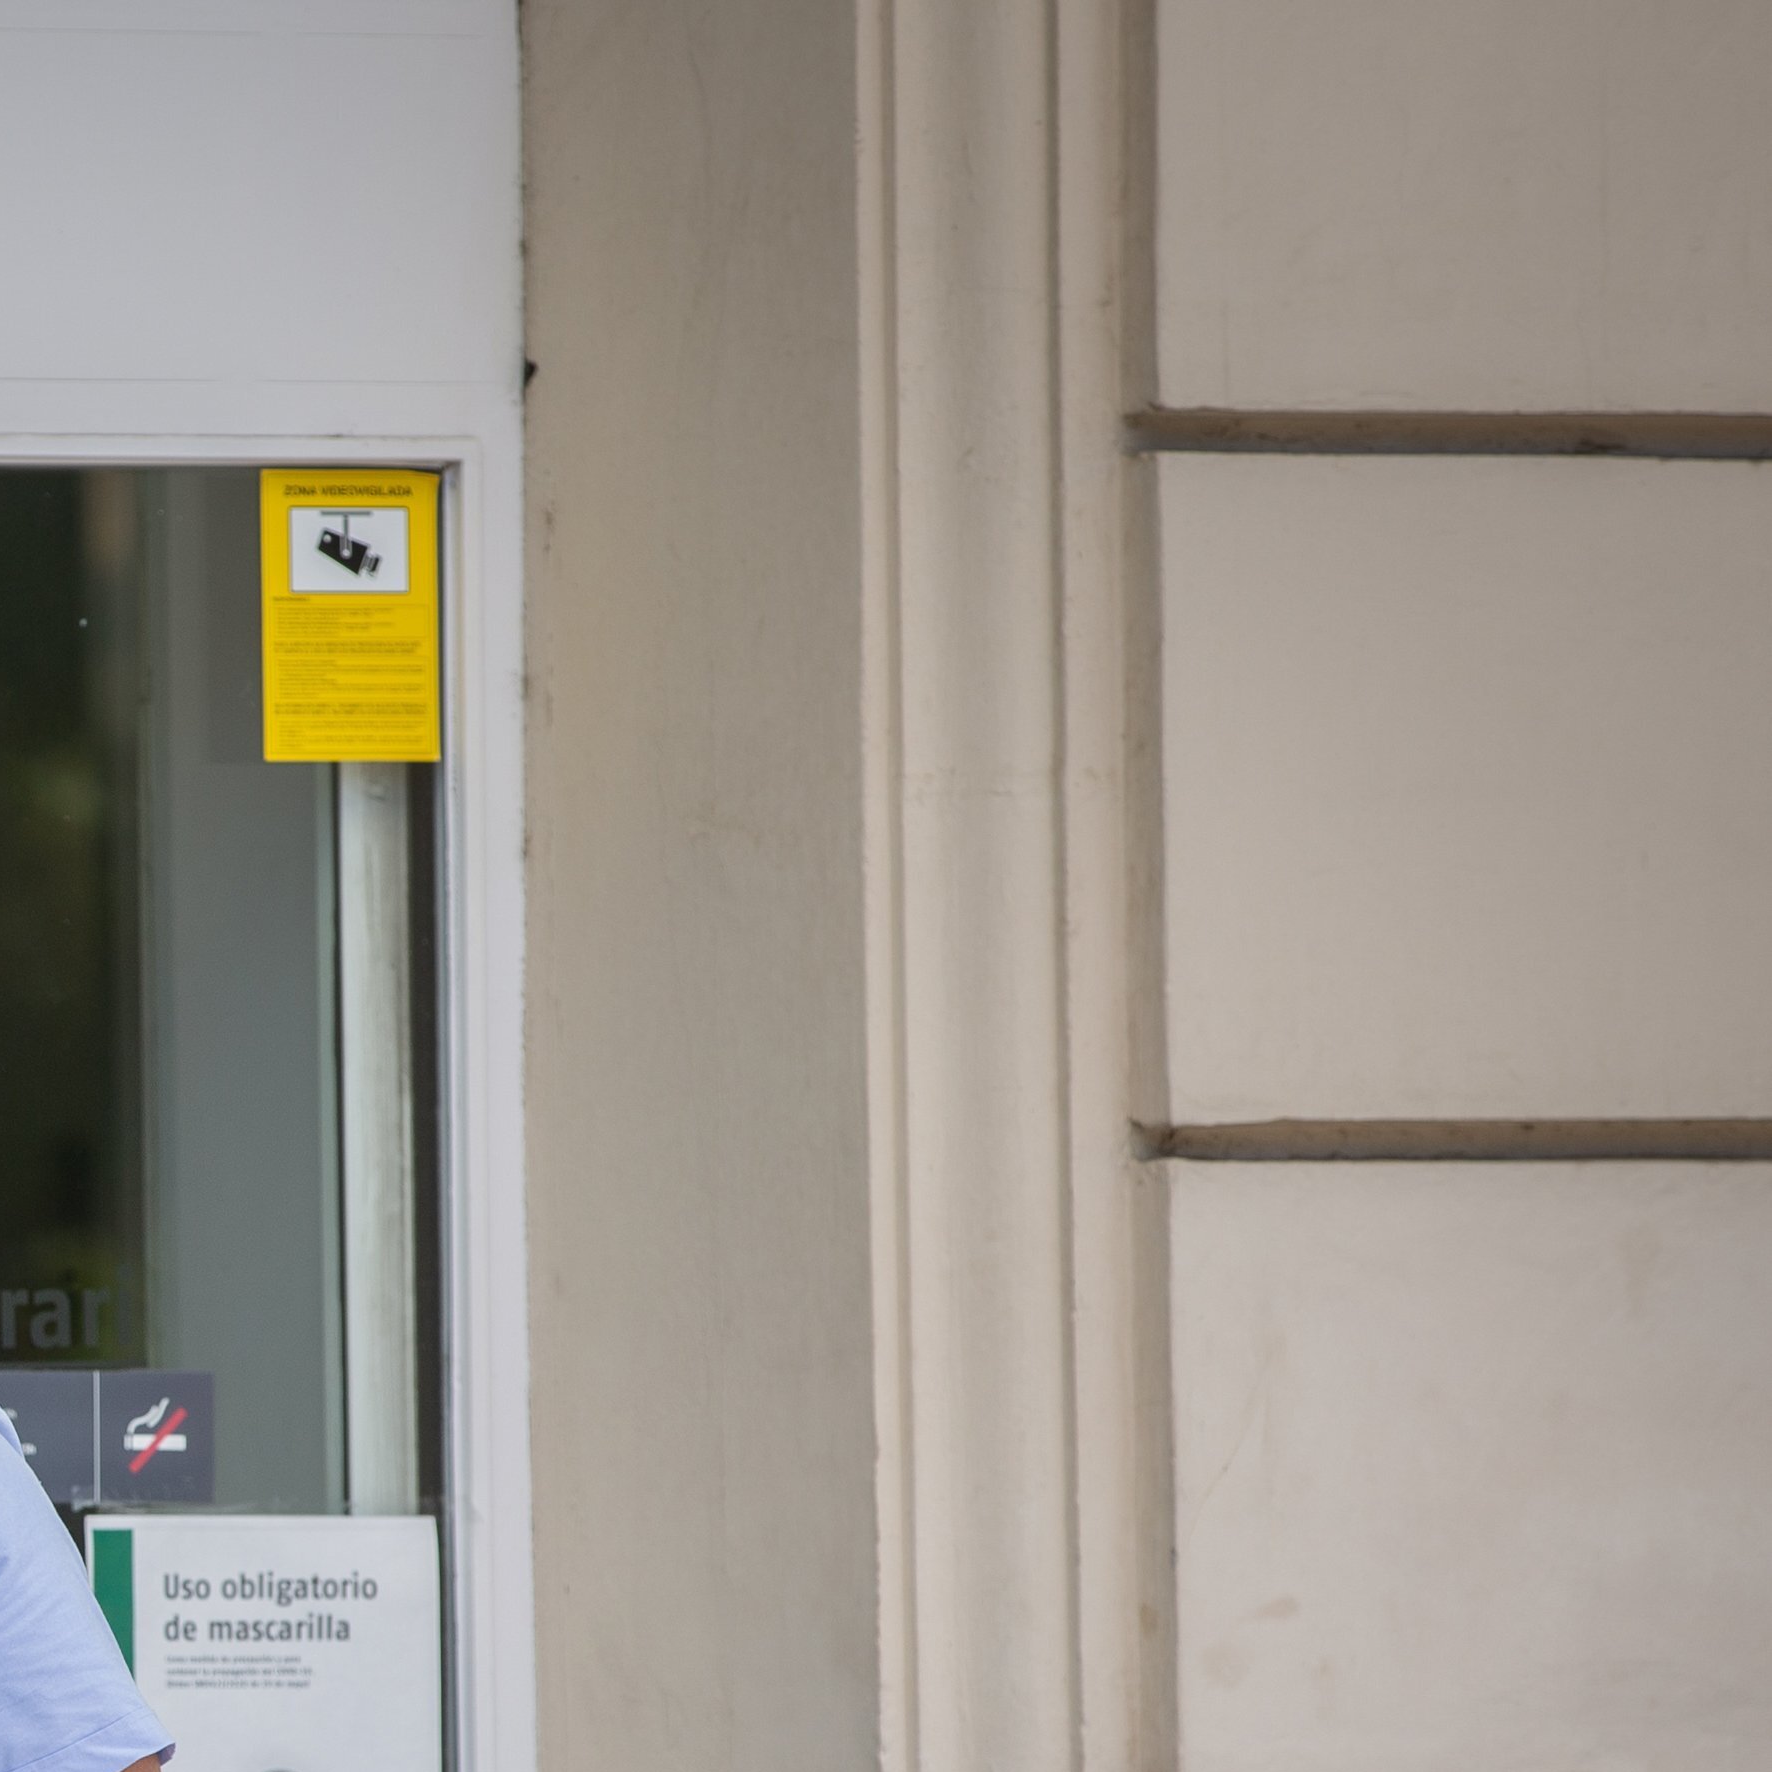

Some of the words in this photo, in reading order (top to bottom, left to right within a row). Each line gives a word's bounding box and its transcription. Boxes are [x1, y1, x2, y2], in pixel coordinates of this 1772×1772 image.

[164, 1573, 210, 1599] Uso
[222, 1570, 378, 1607] obligatorio
[165, 1614, 197, 1640] de
[209, 1612, 350, 1640] mascarilla
